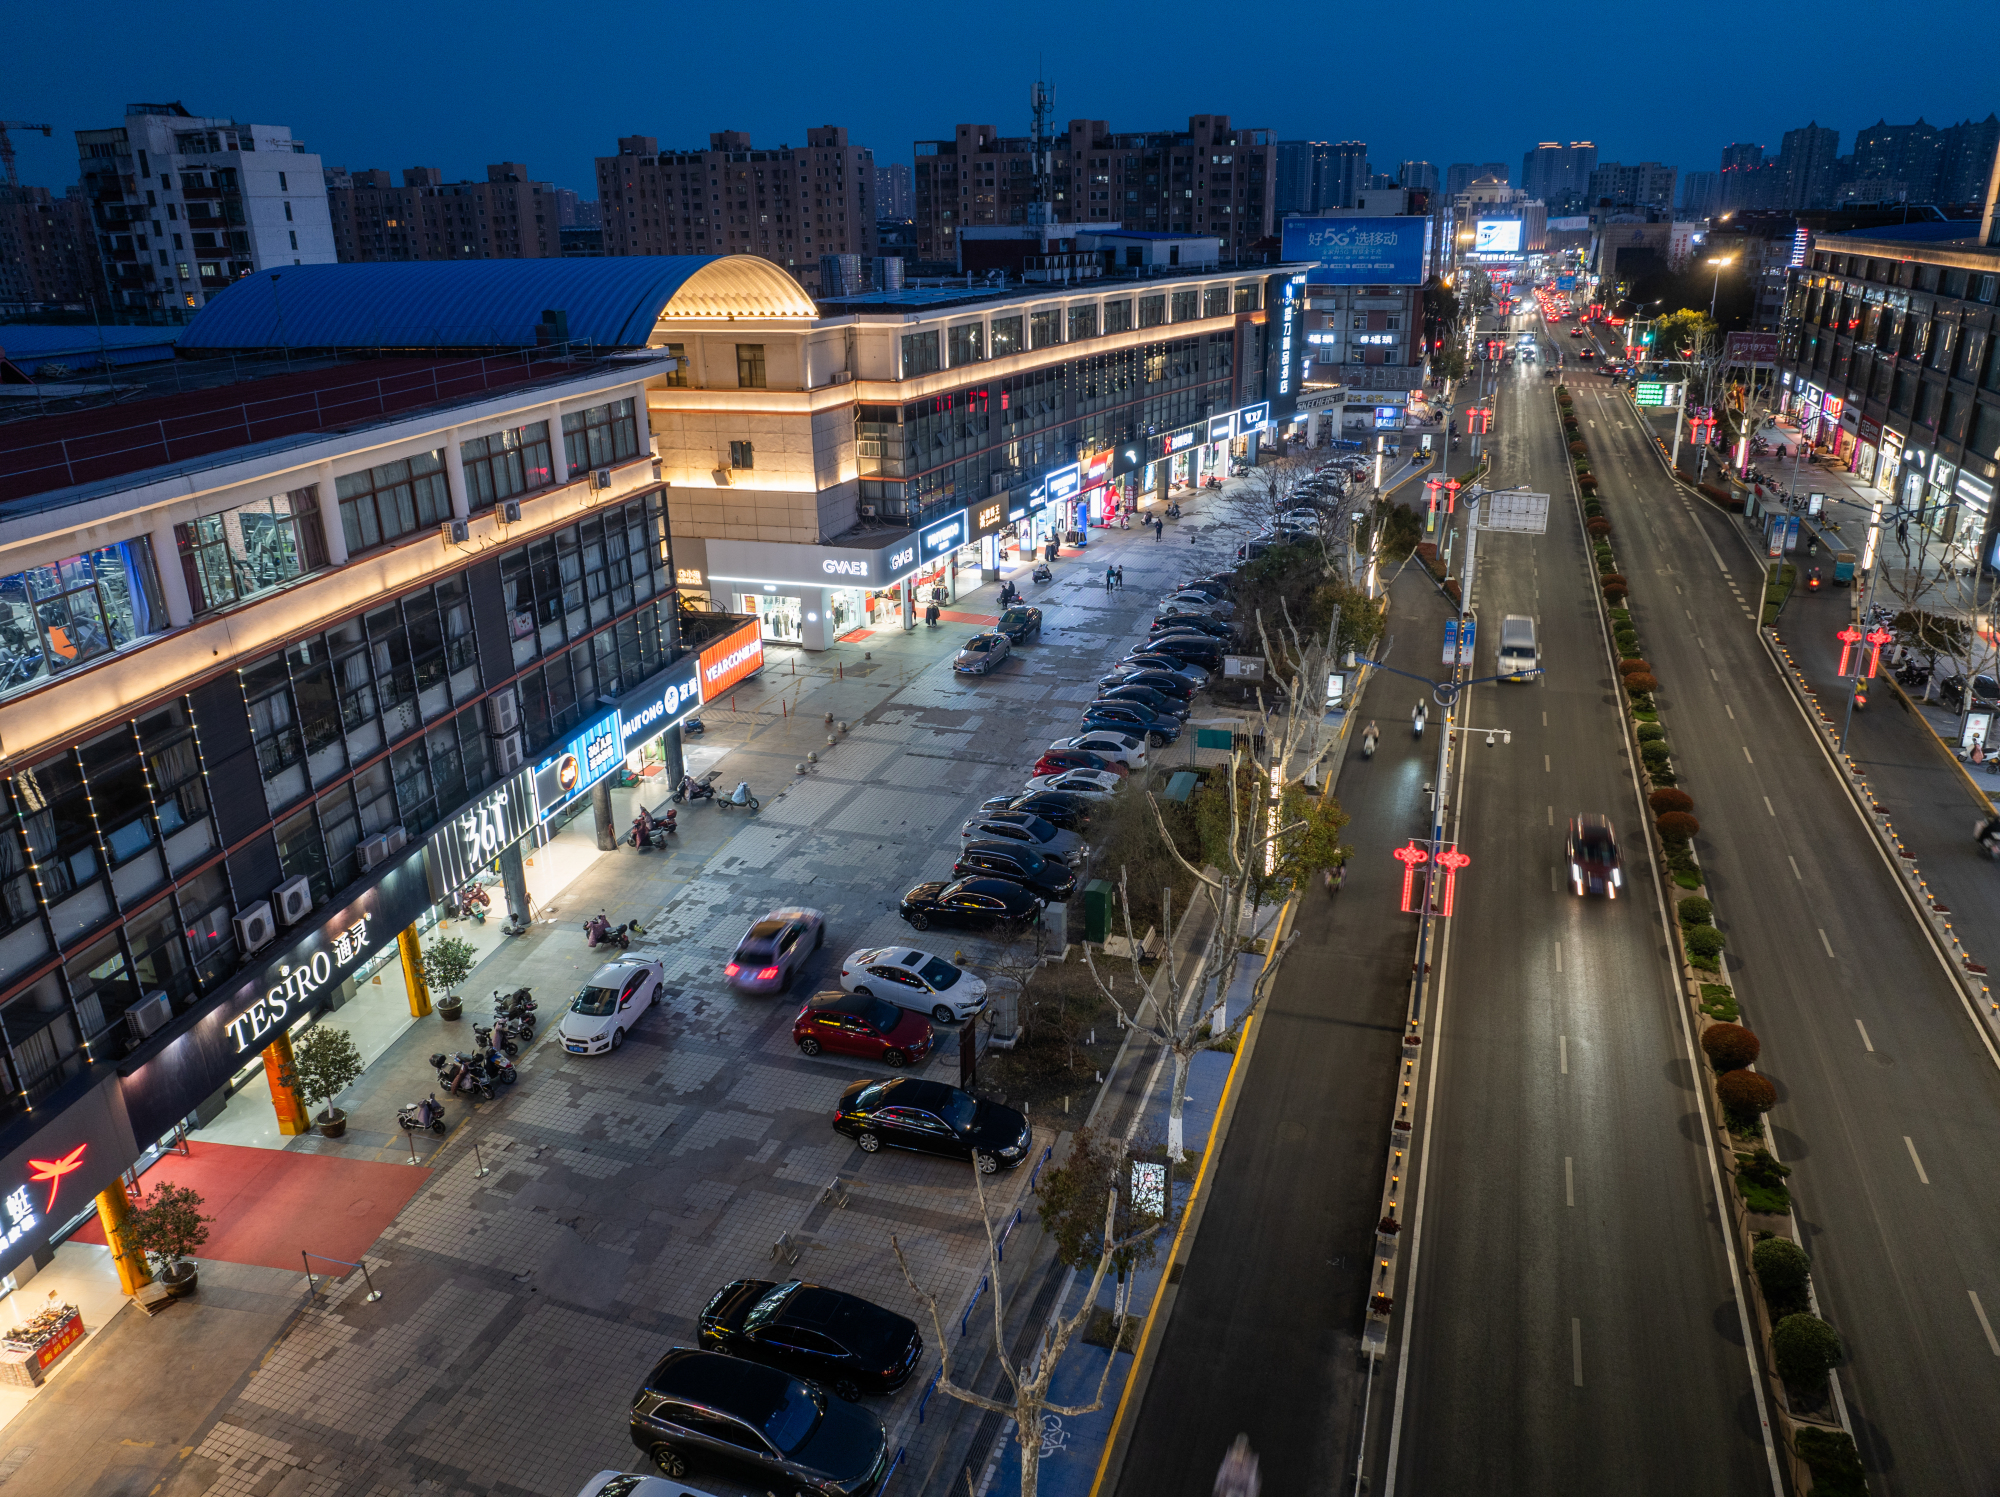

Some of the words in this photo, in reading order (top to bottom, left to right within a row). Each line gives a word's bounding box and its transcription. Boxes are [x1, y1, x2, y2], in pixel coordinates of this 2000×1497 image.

[1296, 395, 1335, 411] SKECHERS
[705, 648, 744, 682] YEARCON
[622, 700, 664, 739] MUTONG
[332, 918, 370, 968] 通灵
